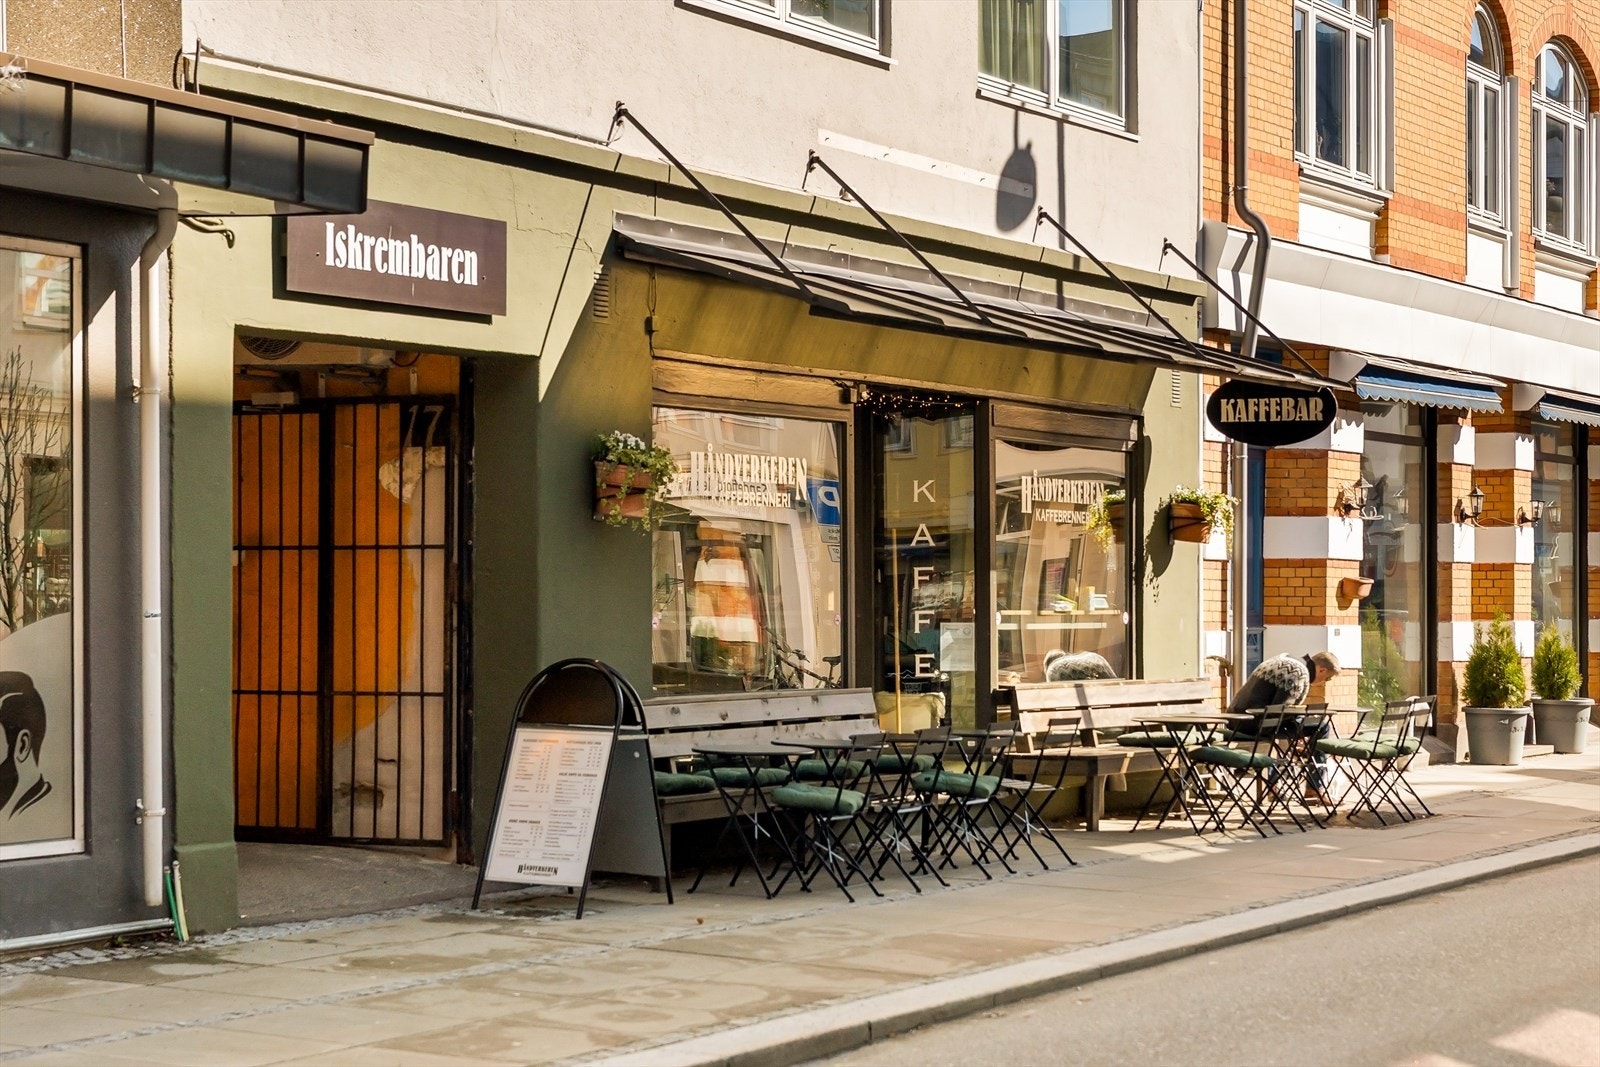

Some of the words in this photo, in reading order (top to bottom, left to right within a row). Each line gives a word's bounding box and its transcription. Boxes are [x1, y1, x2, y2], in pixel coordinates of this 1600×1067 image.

[325, 221, 478, 286] Iskrembaren
[403, 404, 445, 449] 17
[1220, 397, 1324, 423] KAFFEBAR
[690, 443, 808, 501] HÅNDVERKEREN
[711, 491, 791, 508] KAFFEBRENNERI
[1036, 508, 1090, 524] KAFFEBRENNER
[911, 479, 936, 678] KAFFE
